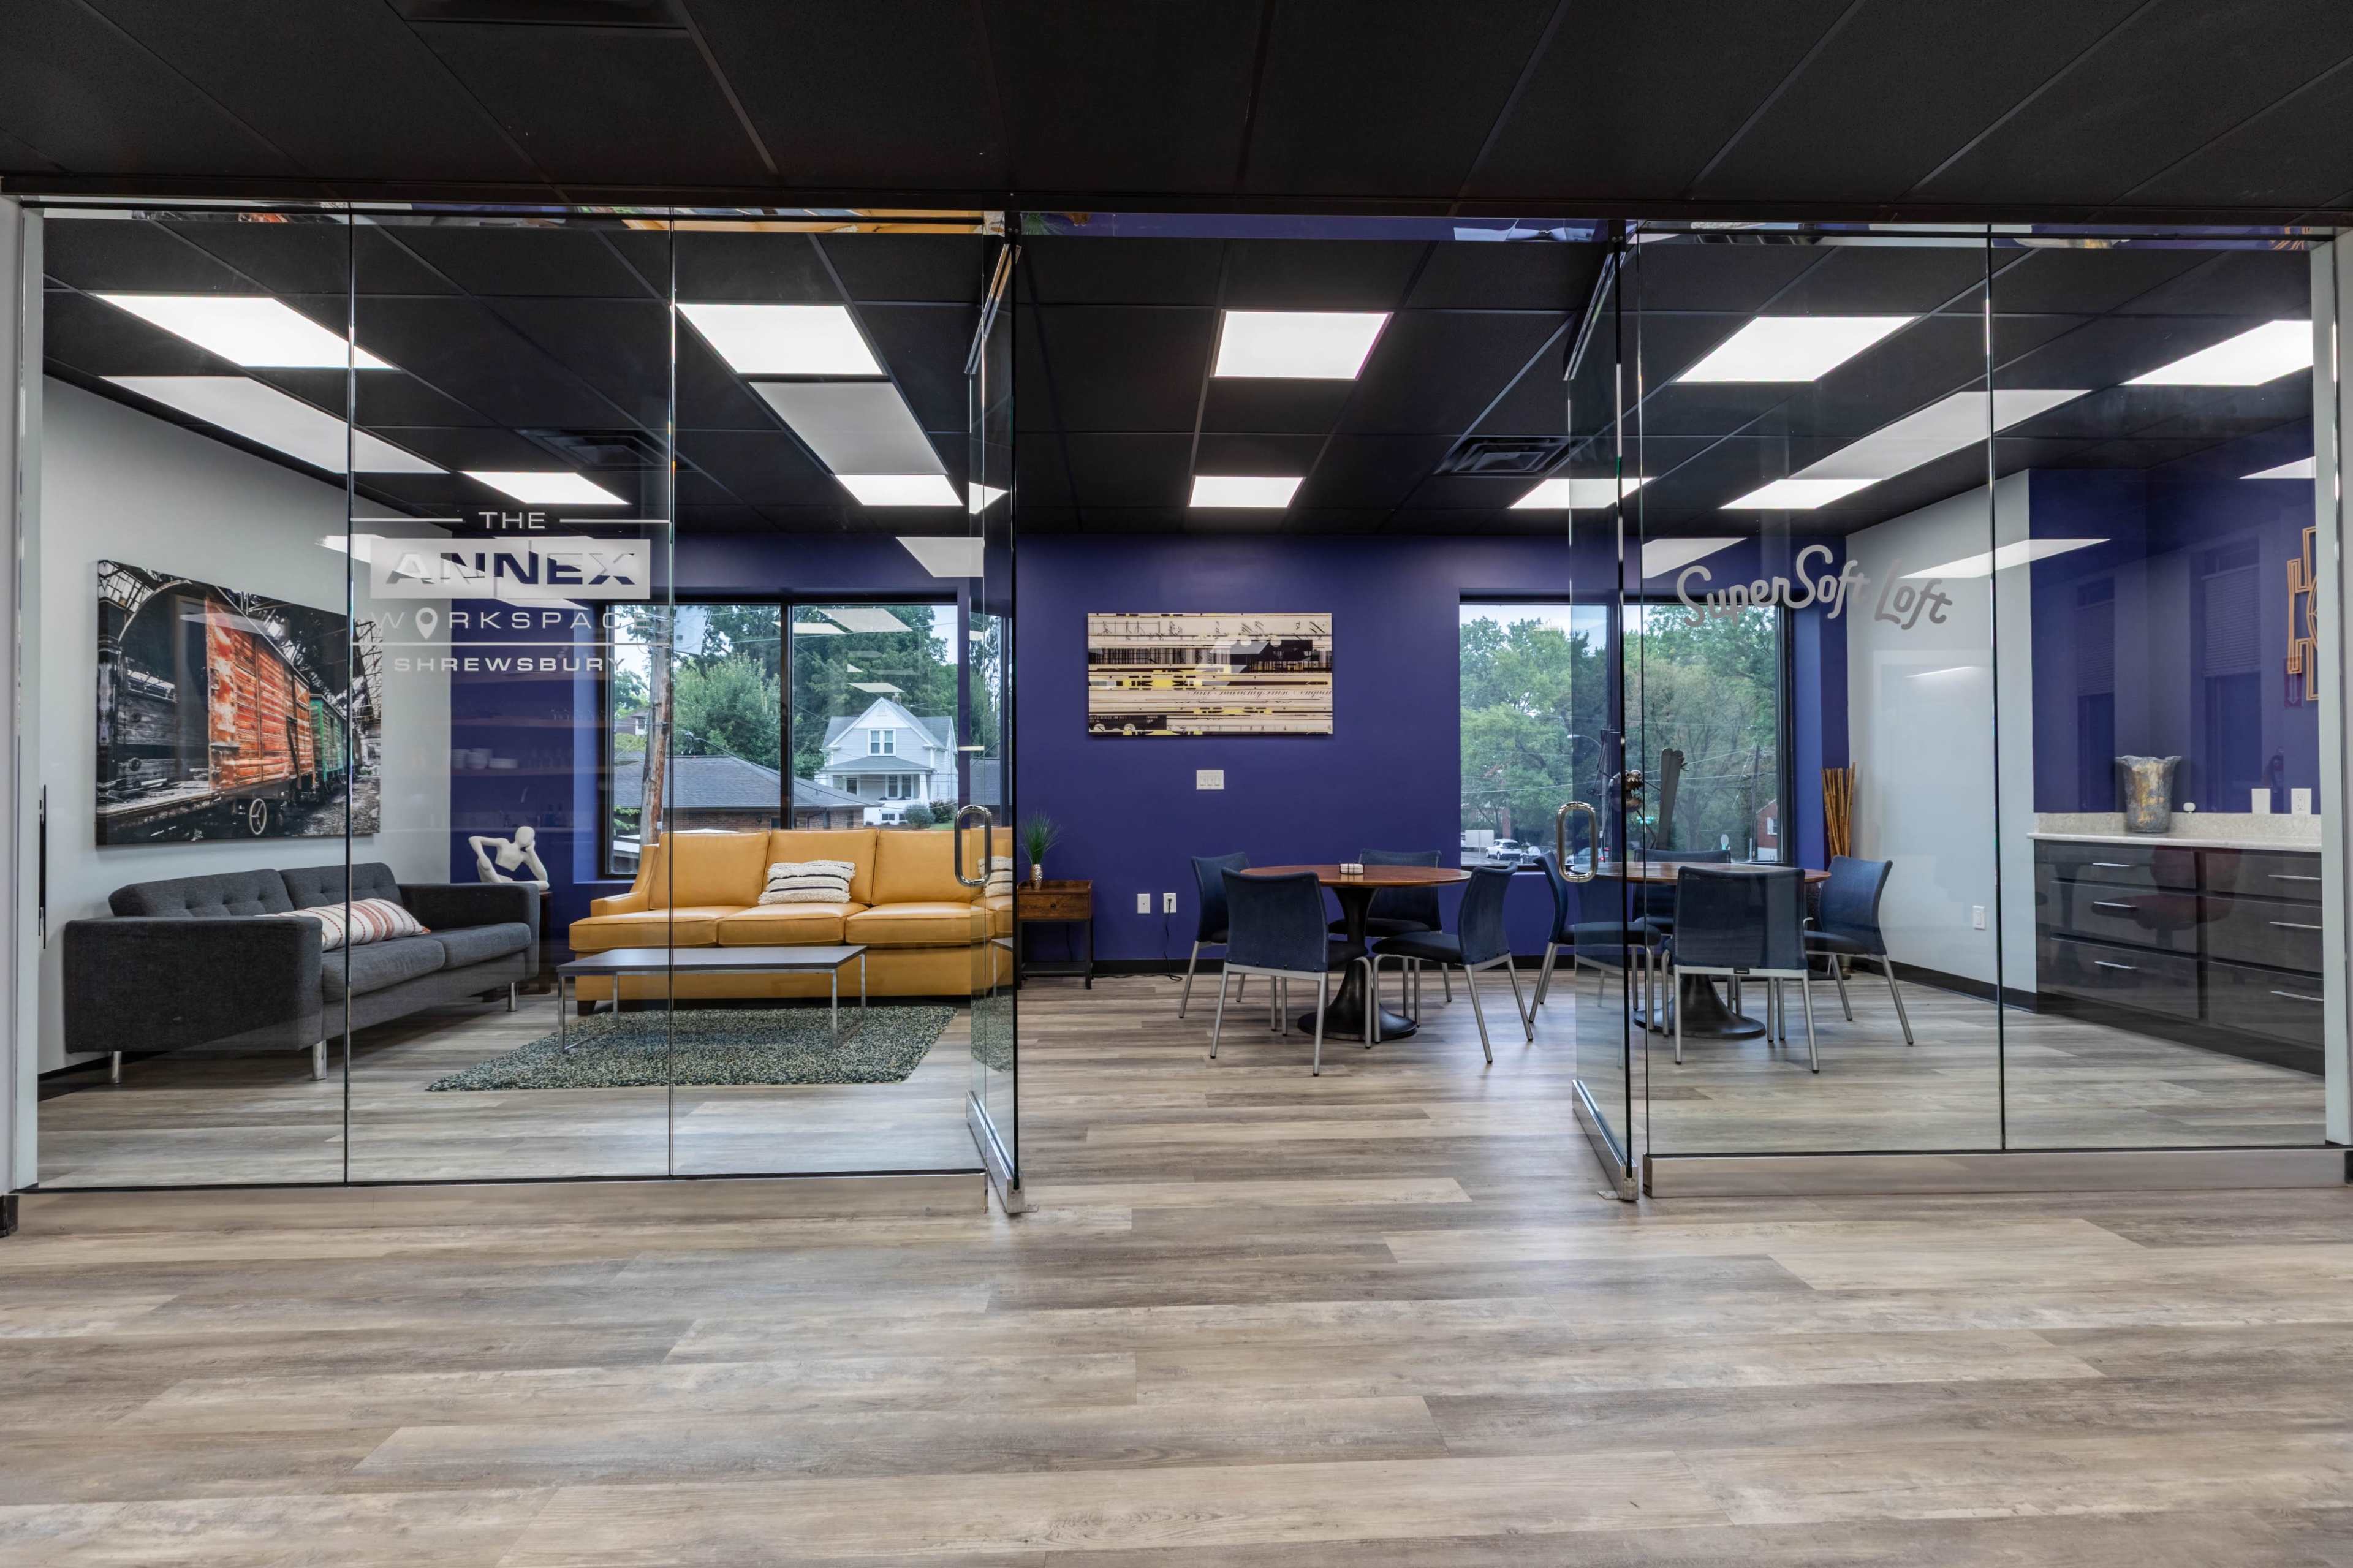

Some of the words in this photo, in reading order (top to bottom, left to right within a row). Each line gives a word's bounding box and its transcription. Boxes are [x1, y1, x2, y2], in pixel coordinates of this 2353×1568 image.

[478, 512, 546, 529] THE
[385, 552, 636, 585] ANNEX
[1874, 559, 1953, 631] Loft
[394, 657, 626, 672] SHREWSBURY
